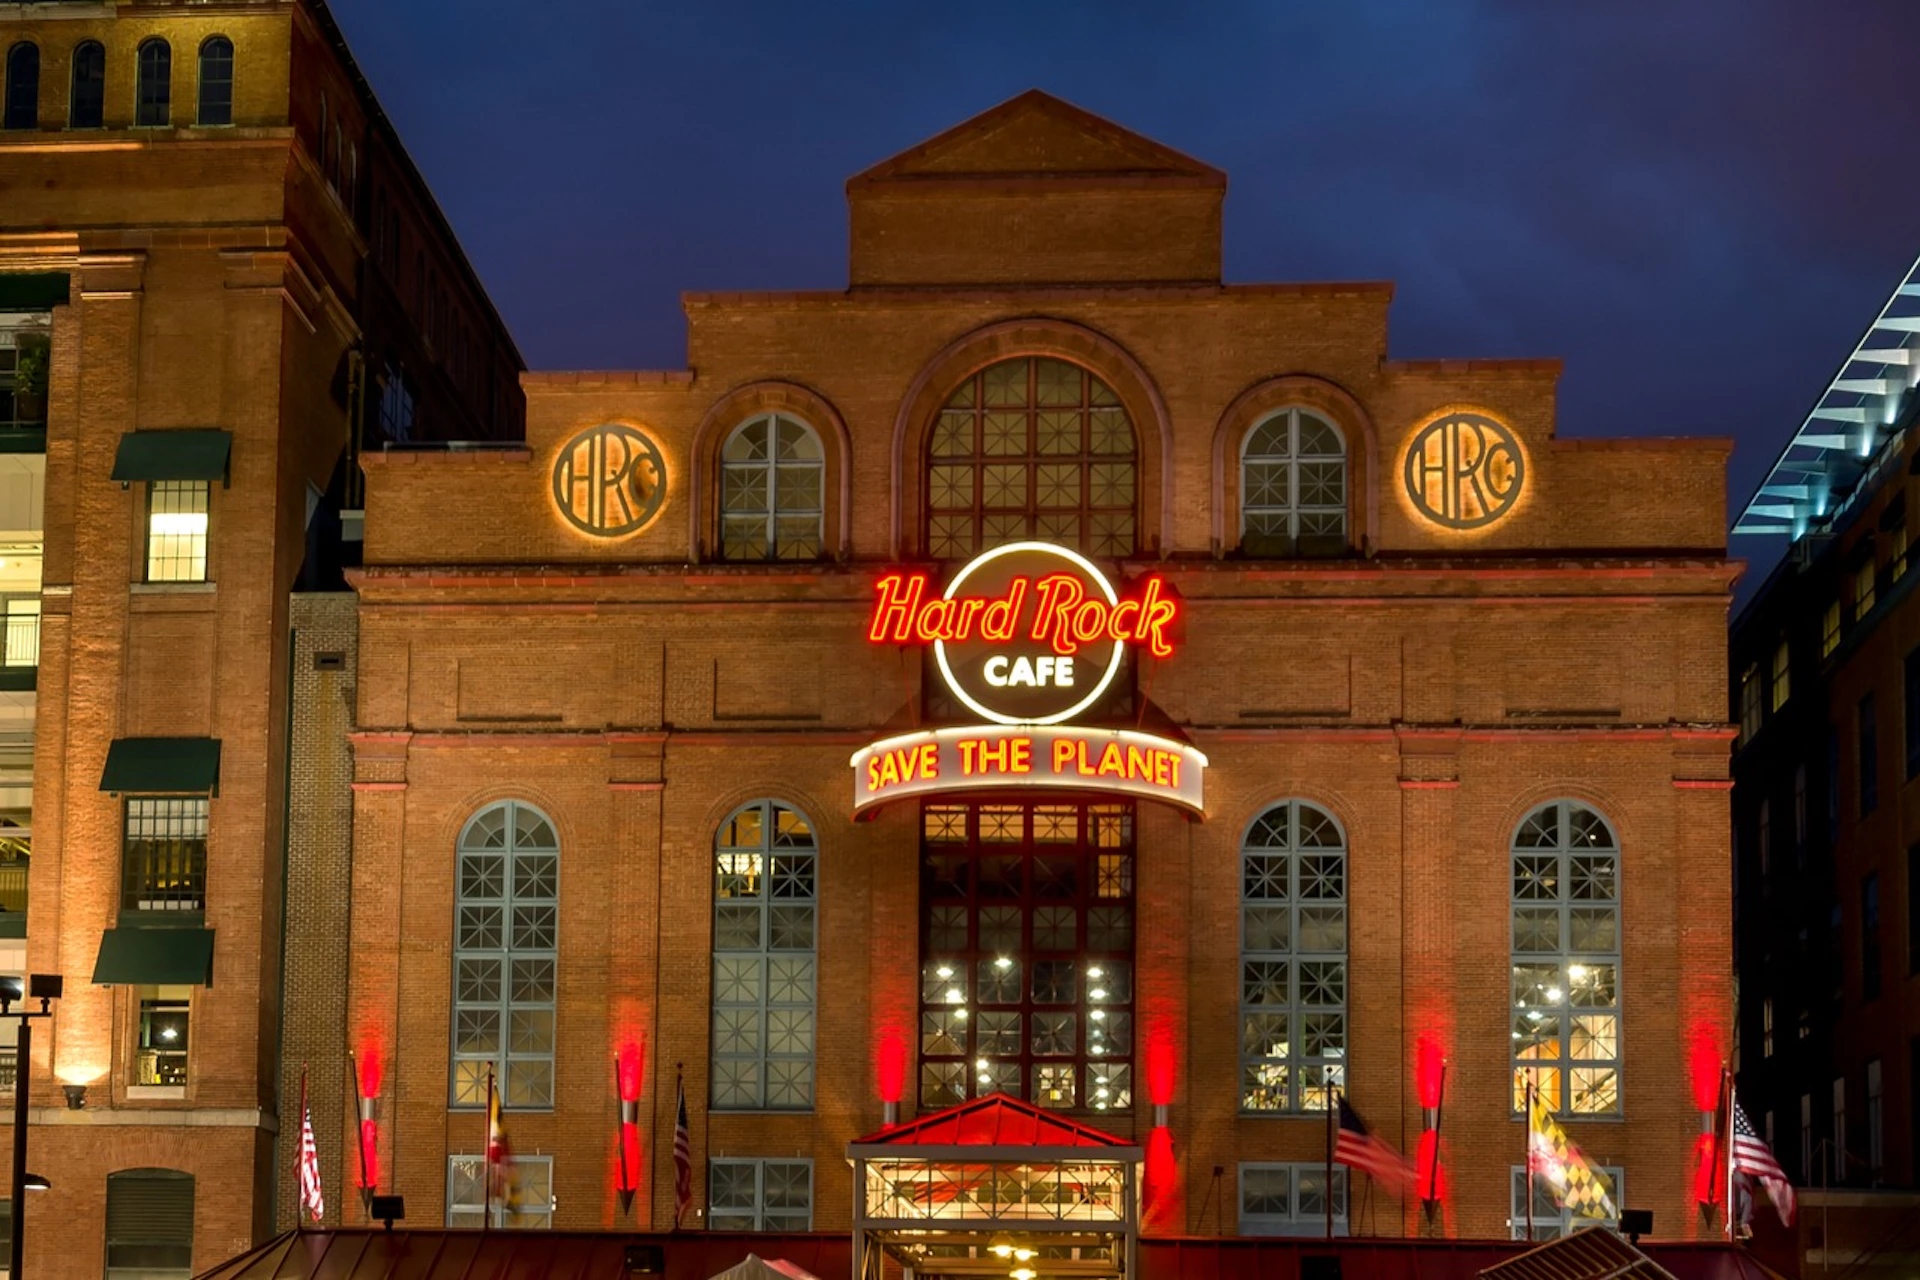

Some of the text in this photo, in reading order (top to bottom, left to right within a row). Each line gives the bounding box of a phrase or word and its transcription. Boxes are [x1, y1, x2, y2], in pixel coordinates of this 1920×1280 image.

[870, 575, 1176, 656] Hard Rock
[983, 656, 1075, 687] CAFE
[868, 738, 1182, 792] SAVE THE PLANET
